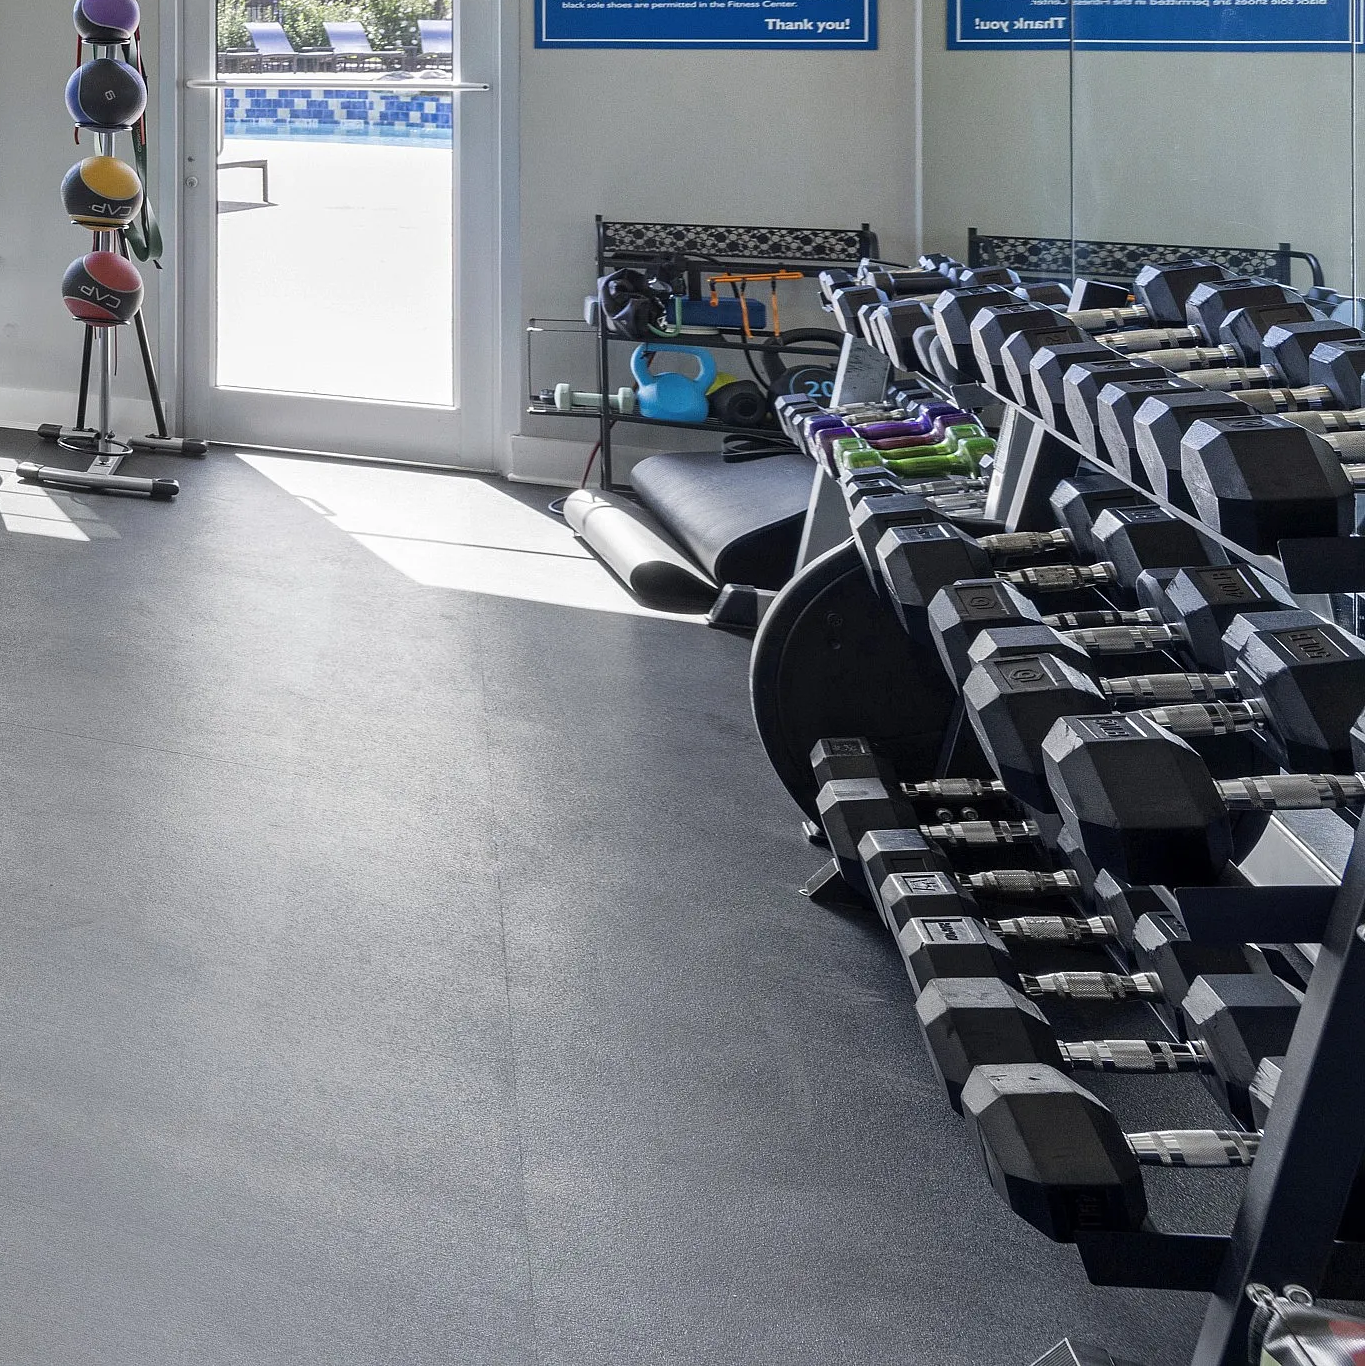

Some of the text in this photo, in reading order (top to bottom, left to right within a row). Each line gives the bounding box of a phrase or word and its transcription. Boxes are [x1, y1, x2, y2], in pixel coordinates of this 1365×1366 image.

[650, 1, 697, 9] permitted
[764, 18, 850, 33] Thank you!
[92, 203, 132, 217] CAP
[80, 285, 121, 309] CAP
[804, 380, 834, 397] 20
